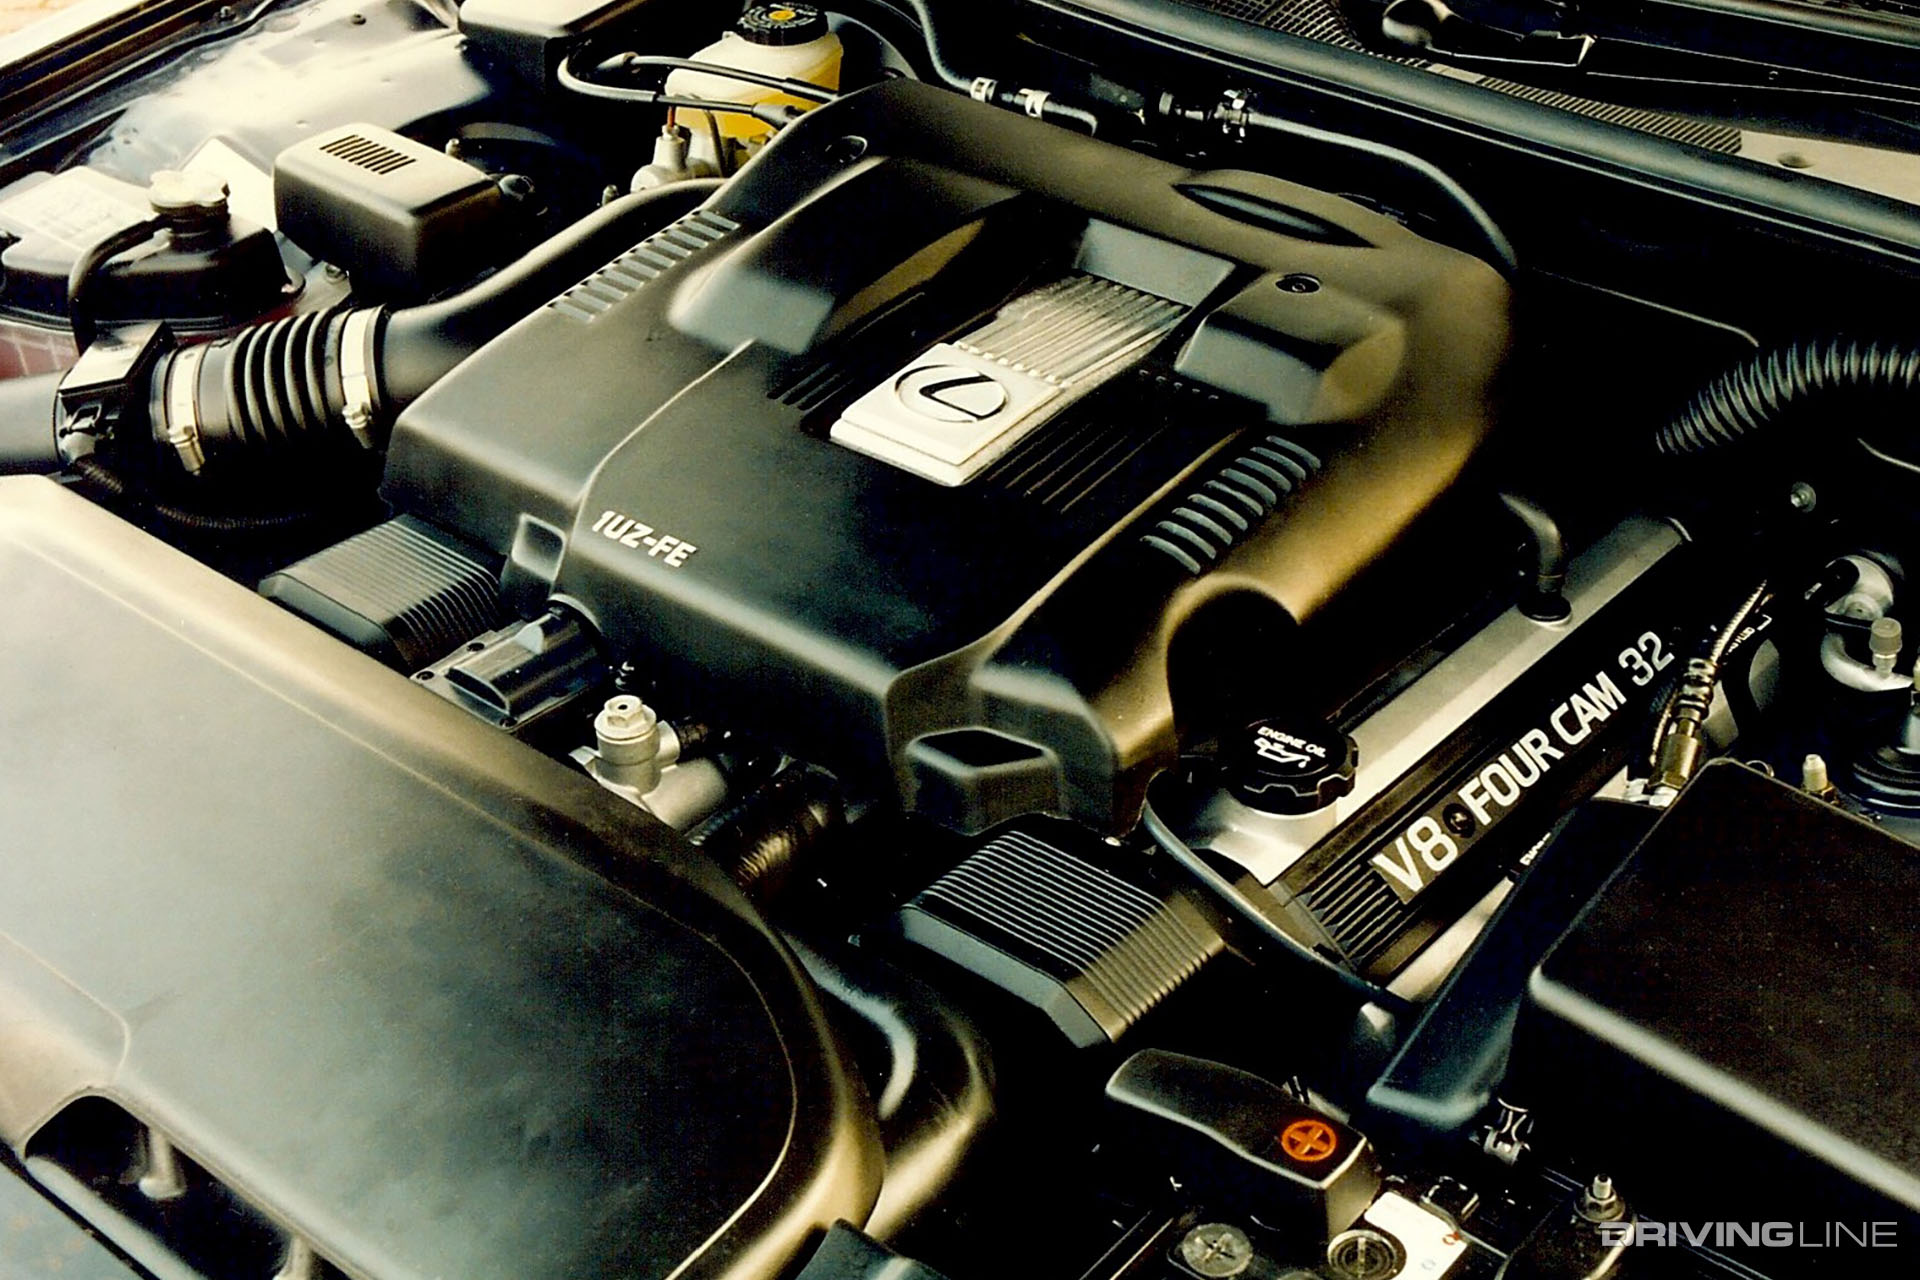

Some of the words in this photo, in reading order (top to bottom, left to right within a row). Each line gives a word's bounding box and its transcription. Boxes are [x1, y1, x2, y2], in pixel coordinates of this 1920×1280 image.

[591, 510, 698, 568] 1UZ-FE
[1257, 726, 1307, 749] ENGINE
[1305, 744, 1326, 758] OIL
[1371, 815, 1458, 892] V8
[1457, 728, 1565, 826] FOUR
[1550, 670, 1627, 746] CAM
[1618, 631, 1675, 687] 32
